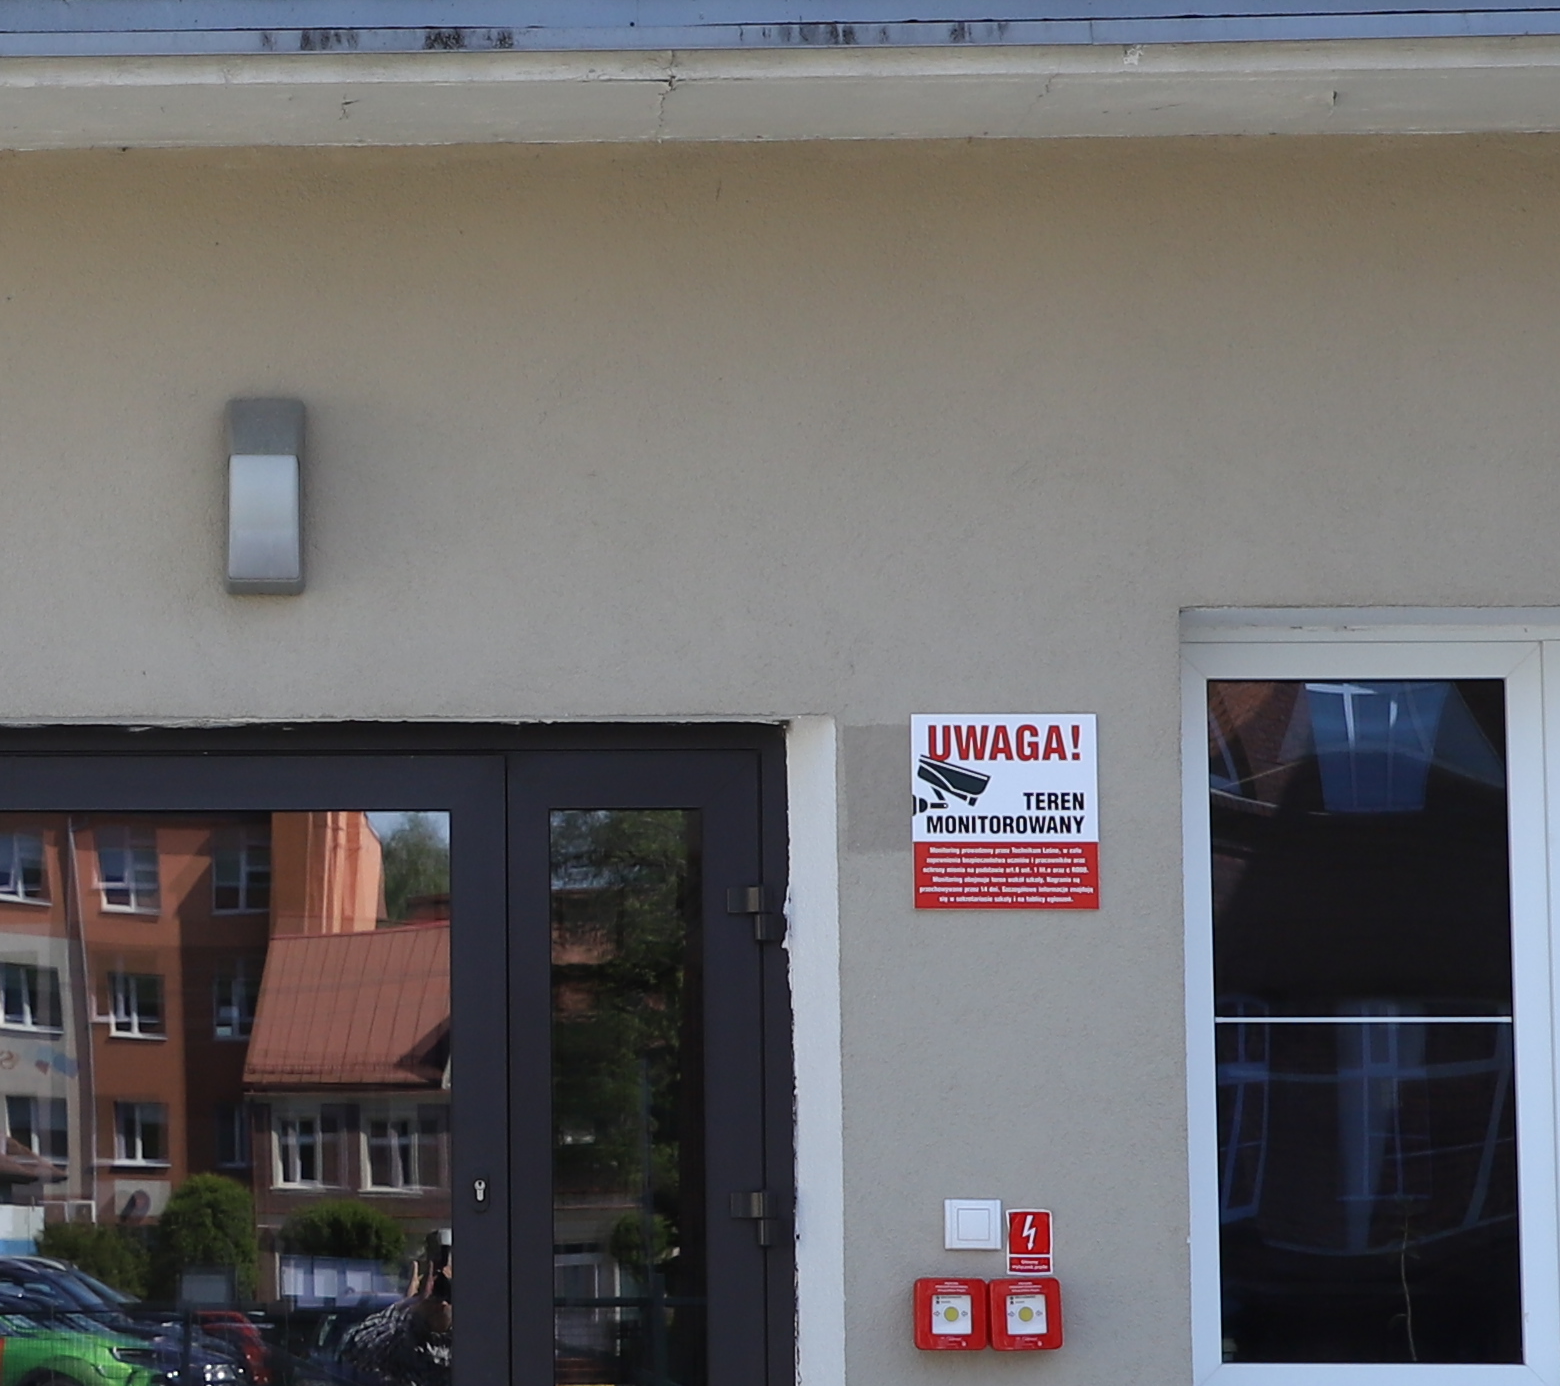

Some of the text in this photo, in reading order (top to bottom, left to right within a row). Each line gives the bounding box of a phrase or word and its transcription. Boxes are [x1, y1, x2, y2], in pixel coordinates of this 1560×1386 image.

[927, 724, 1081, 762] UWAGA!
[1024, 793, 1084, 810] TEREN
[927, 816, 1083, 833] MONITOROWANY
